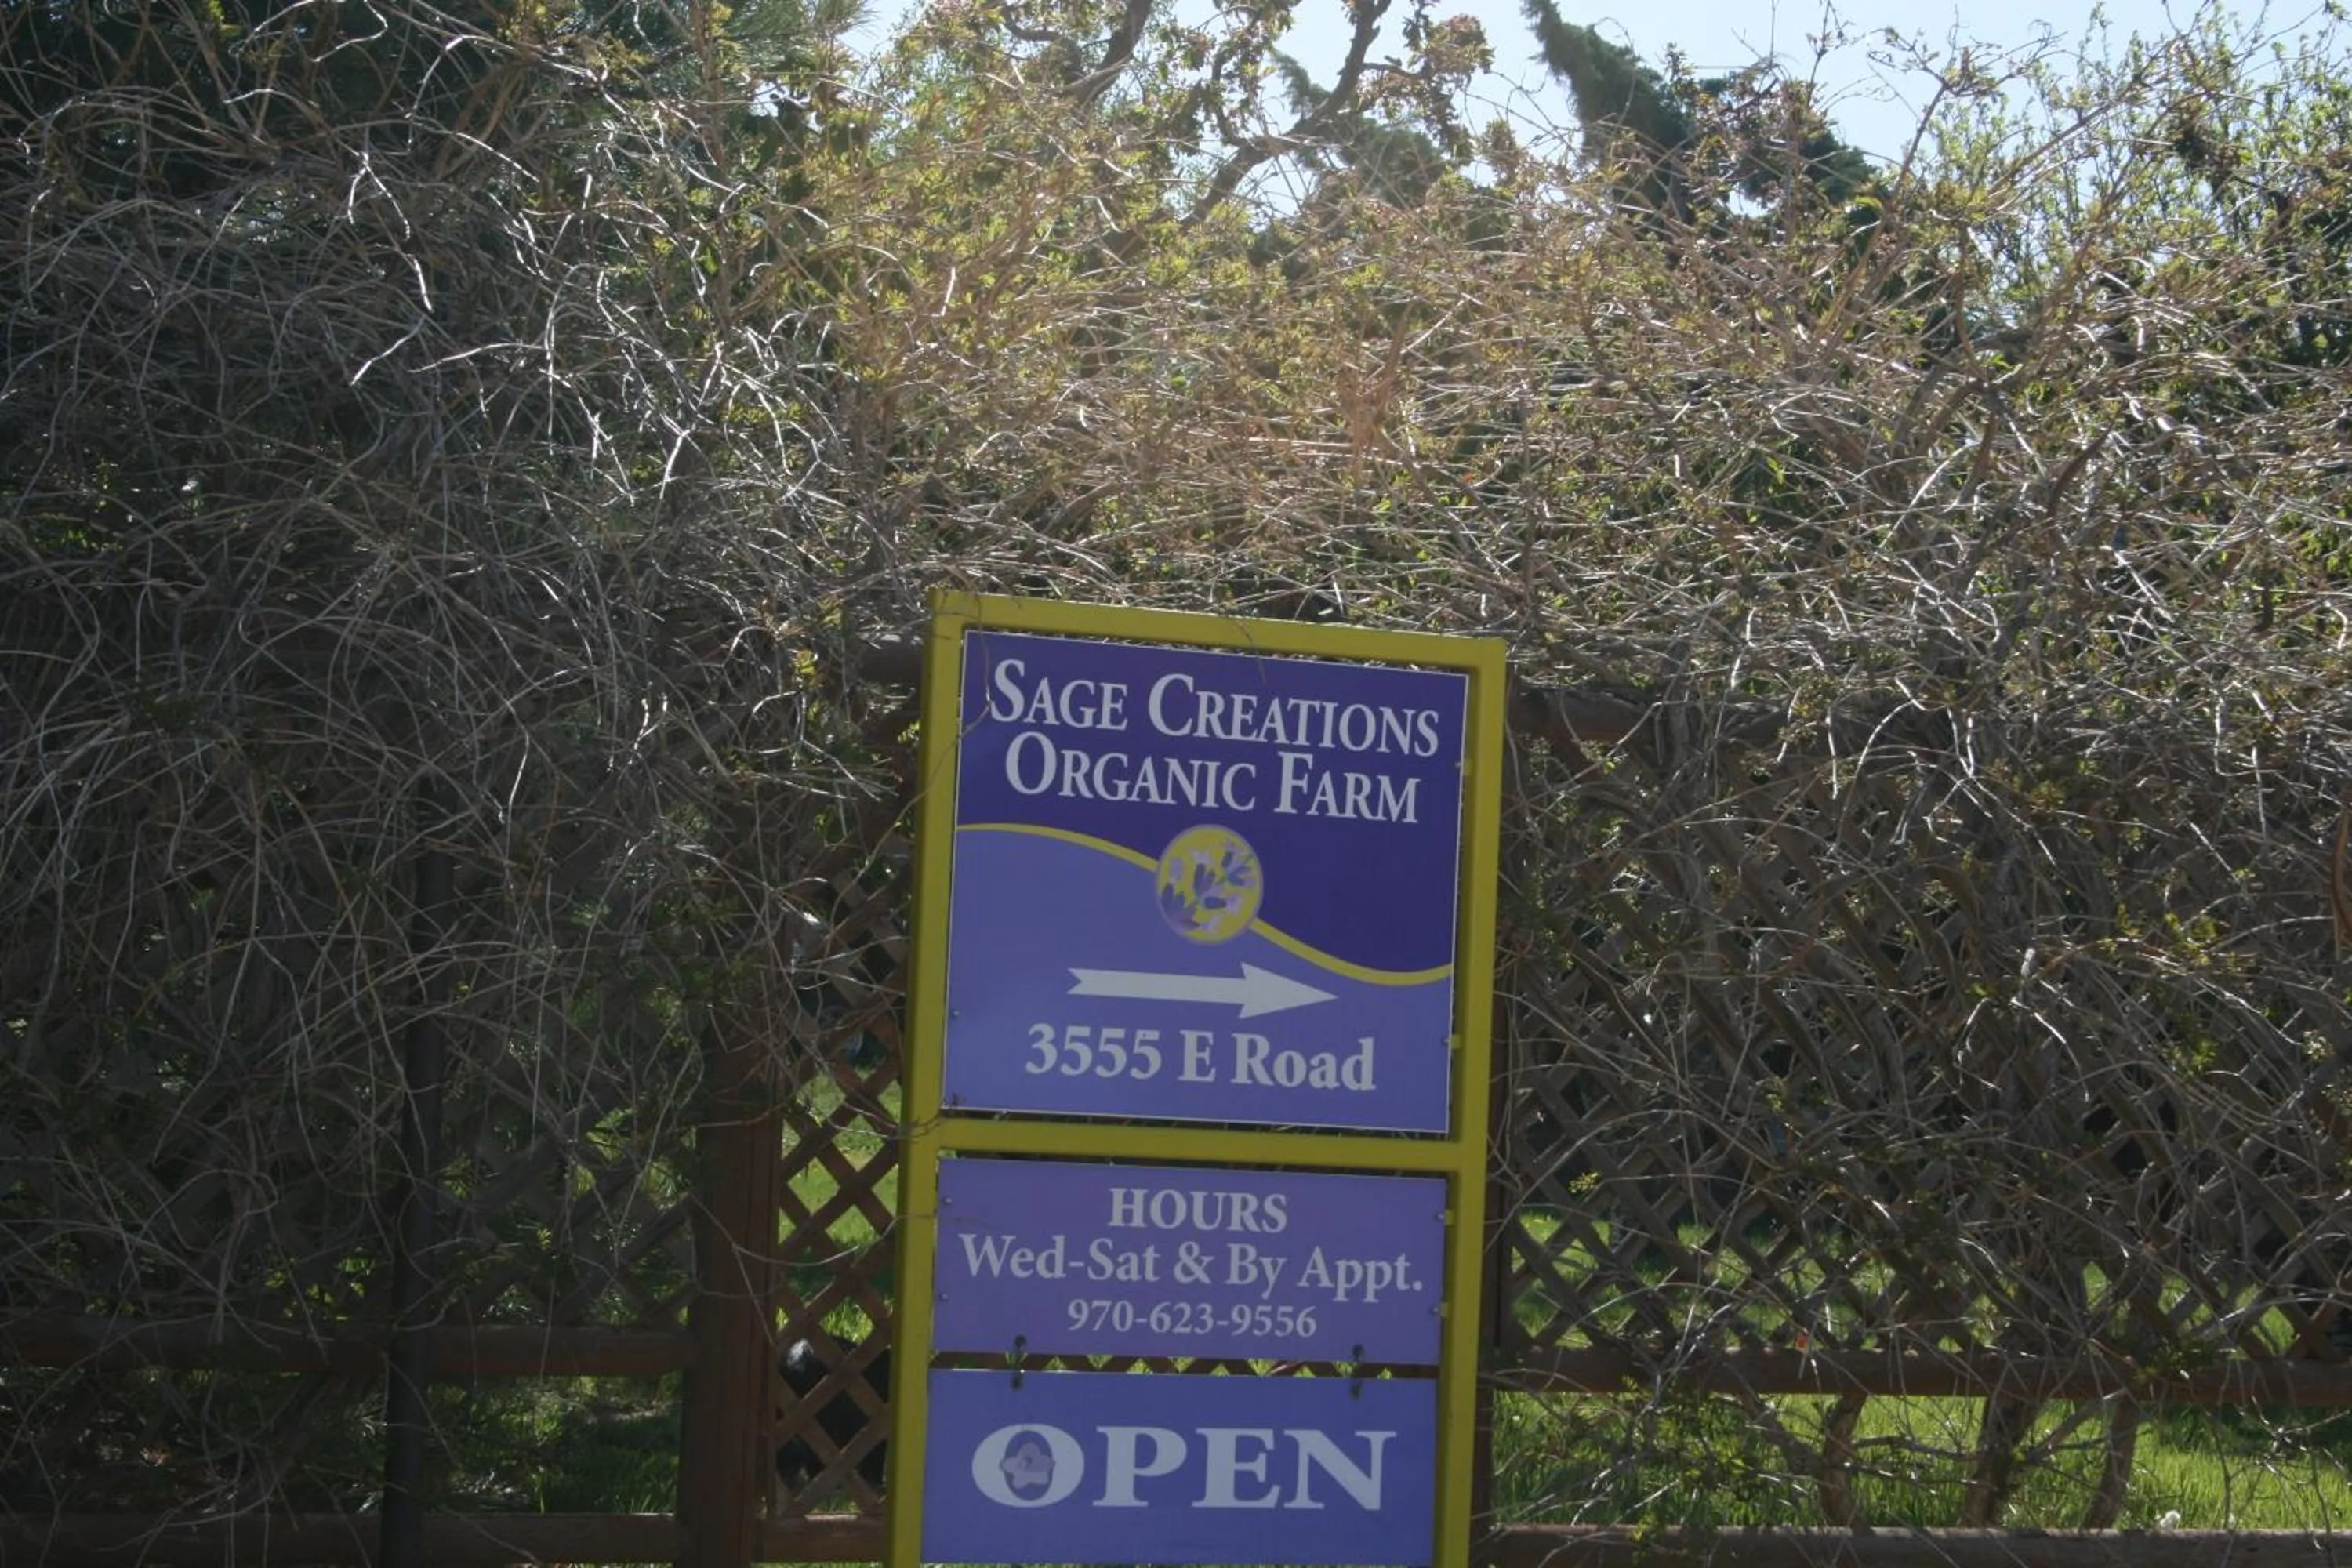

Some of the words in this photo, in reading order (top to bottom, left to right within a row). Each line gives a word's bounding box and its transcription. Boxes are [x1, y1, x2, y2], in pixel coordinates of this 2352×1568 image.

[991, 659, 1127, 731] SAGE
[1149, 673, 1439, 757] CREATIONS
[1005, 731, 1255, 811] ORGANIC
[1274, 750, 1420, 823] FARM
[1025, 1022, 1161, 1080] 3555
[1178, 1030, 1215, 1082] E
[1231, 1033, 1376, 1091] Road
[1108, 1187, 1288, 1232] HOURS
[959, 1233, 1159, 1284] Wed-Sat
[1174, 1241, 1213, 1284] &
[1225, 1243, 1285, 1299] By
[1298, 1246, 1422, 1302] Appt.
[1067, 1299, 1317, 1338] 970-623-9556
[971, 1423, 1396, 1511] OPEN
